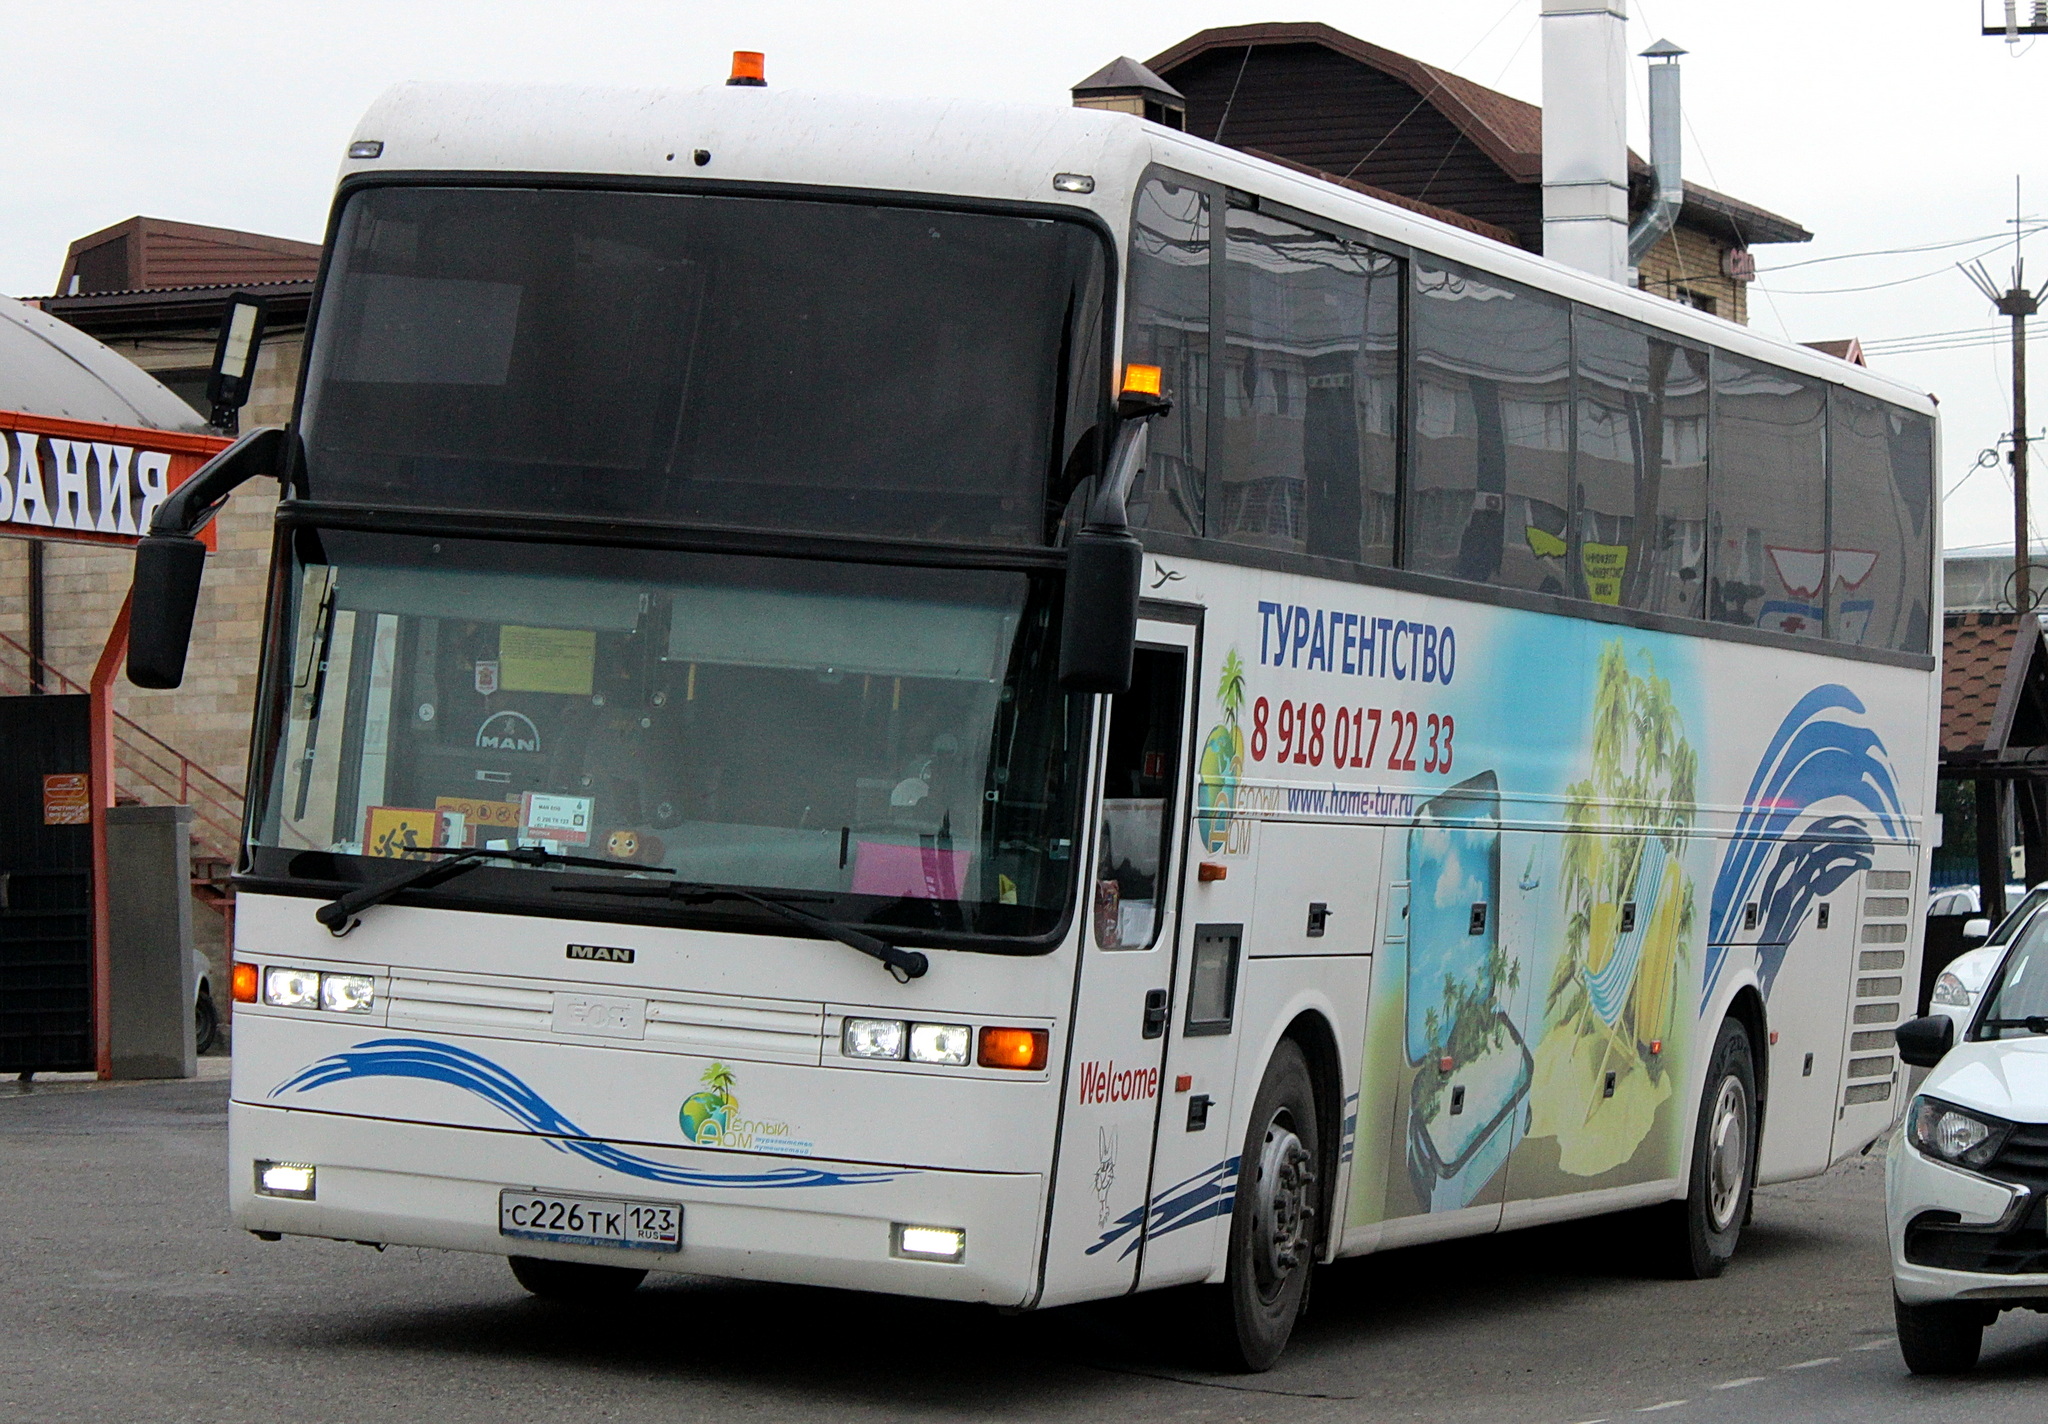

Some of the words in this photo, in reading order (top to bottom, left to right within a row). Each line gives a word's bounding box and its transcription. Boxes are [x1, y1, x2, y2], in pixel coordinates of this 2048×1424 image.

[1257, 600, 1456, 686] ТУРАГЕНТСТВО
[481, 735, 535, 752] MAN
[1251, 696, 1269, 762] 8
[1277, 699, 1326, 767] 918
[1333, 706, 1382, 770] 017
[1387, 710, 1418, 771] 22
[1424, 713, 1455, 775] 33
[1287, 782, 1414, 817] www.home-tur.ru
[571, 945, 630, 962] MAN
[1080, 1060, 1157, 1105] Welcome
[629, 1207, 671, 1231] 123
[637, 1229, 659, 1240] RUS
